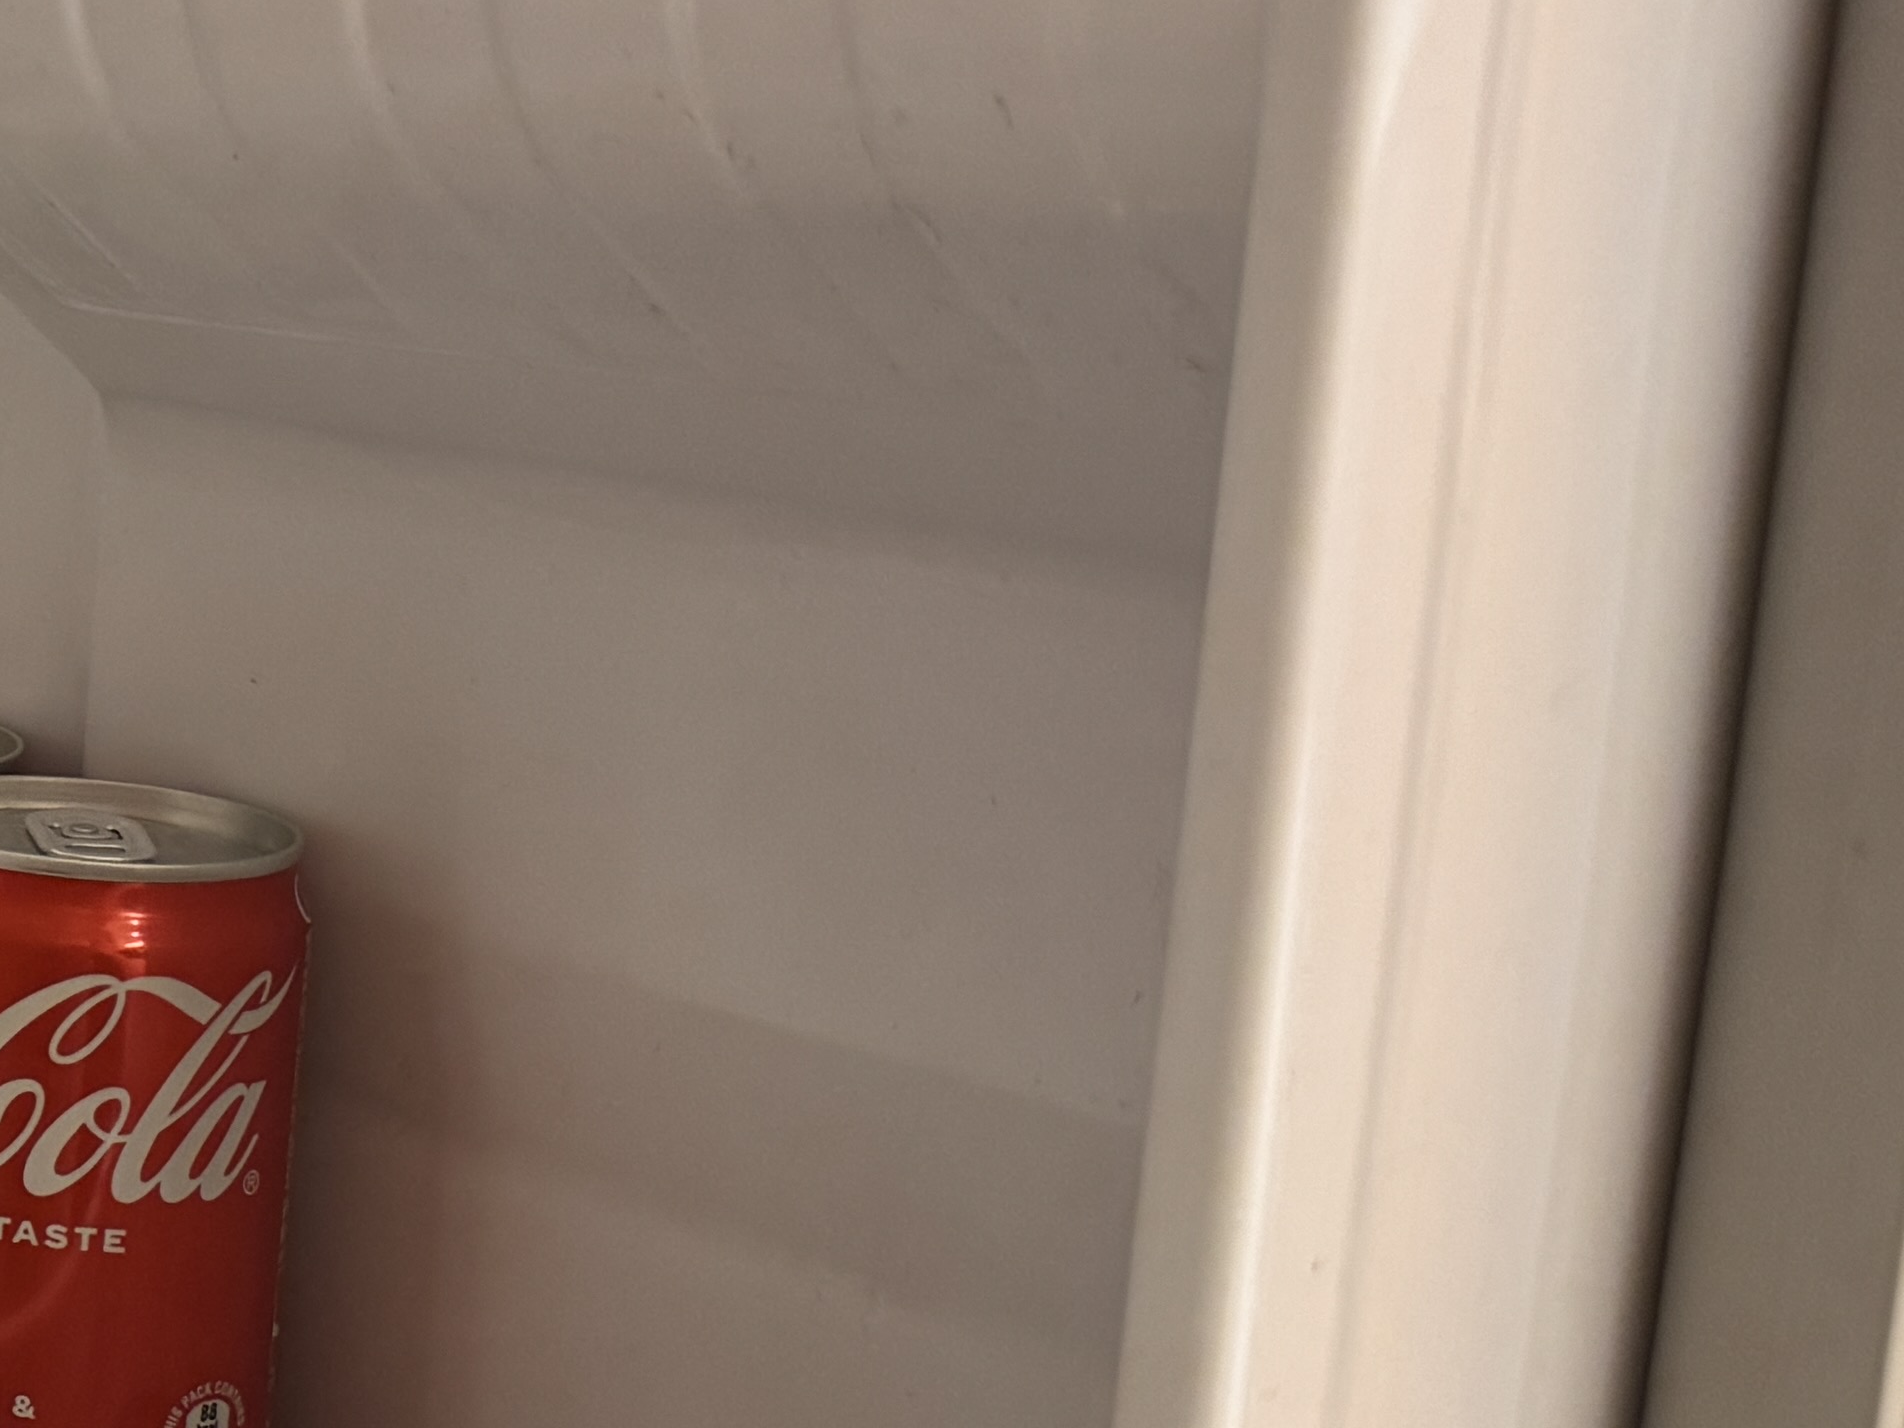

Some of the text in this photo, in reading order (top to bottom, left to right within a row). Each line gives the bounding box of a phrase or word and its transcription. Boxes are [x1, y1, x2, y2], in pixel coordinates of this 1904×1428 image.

[11, 1394, 36, 1420] &
[181, 1381, 213, 1410] PACK
[200, 1402, 218, 1422] 88
